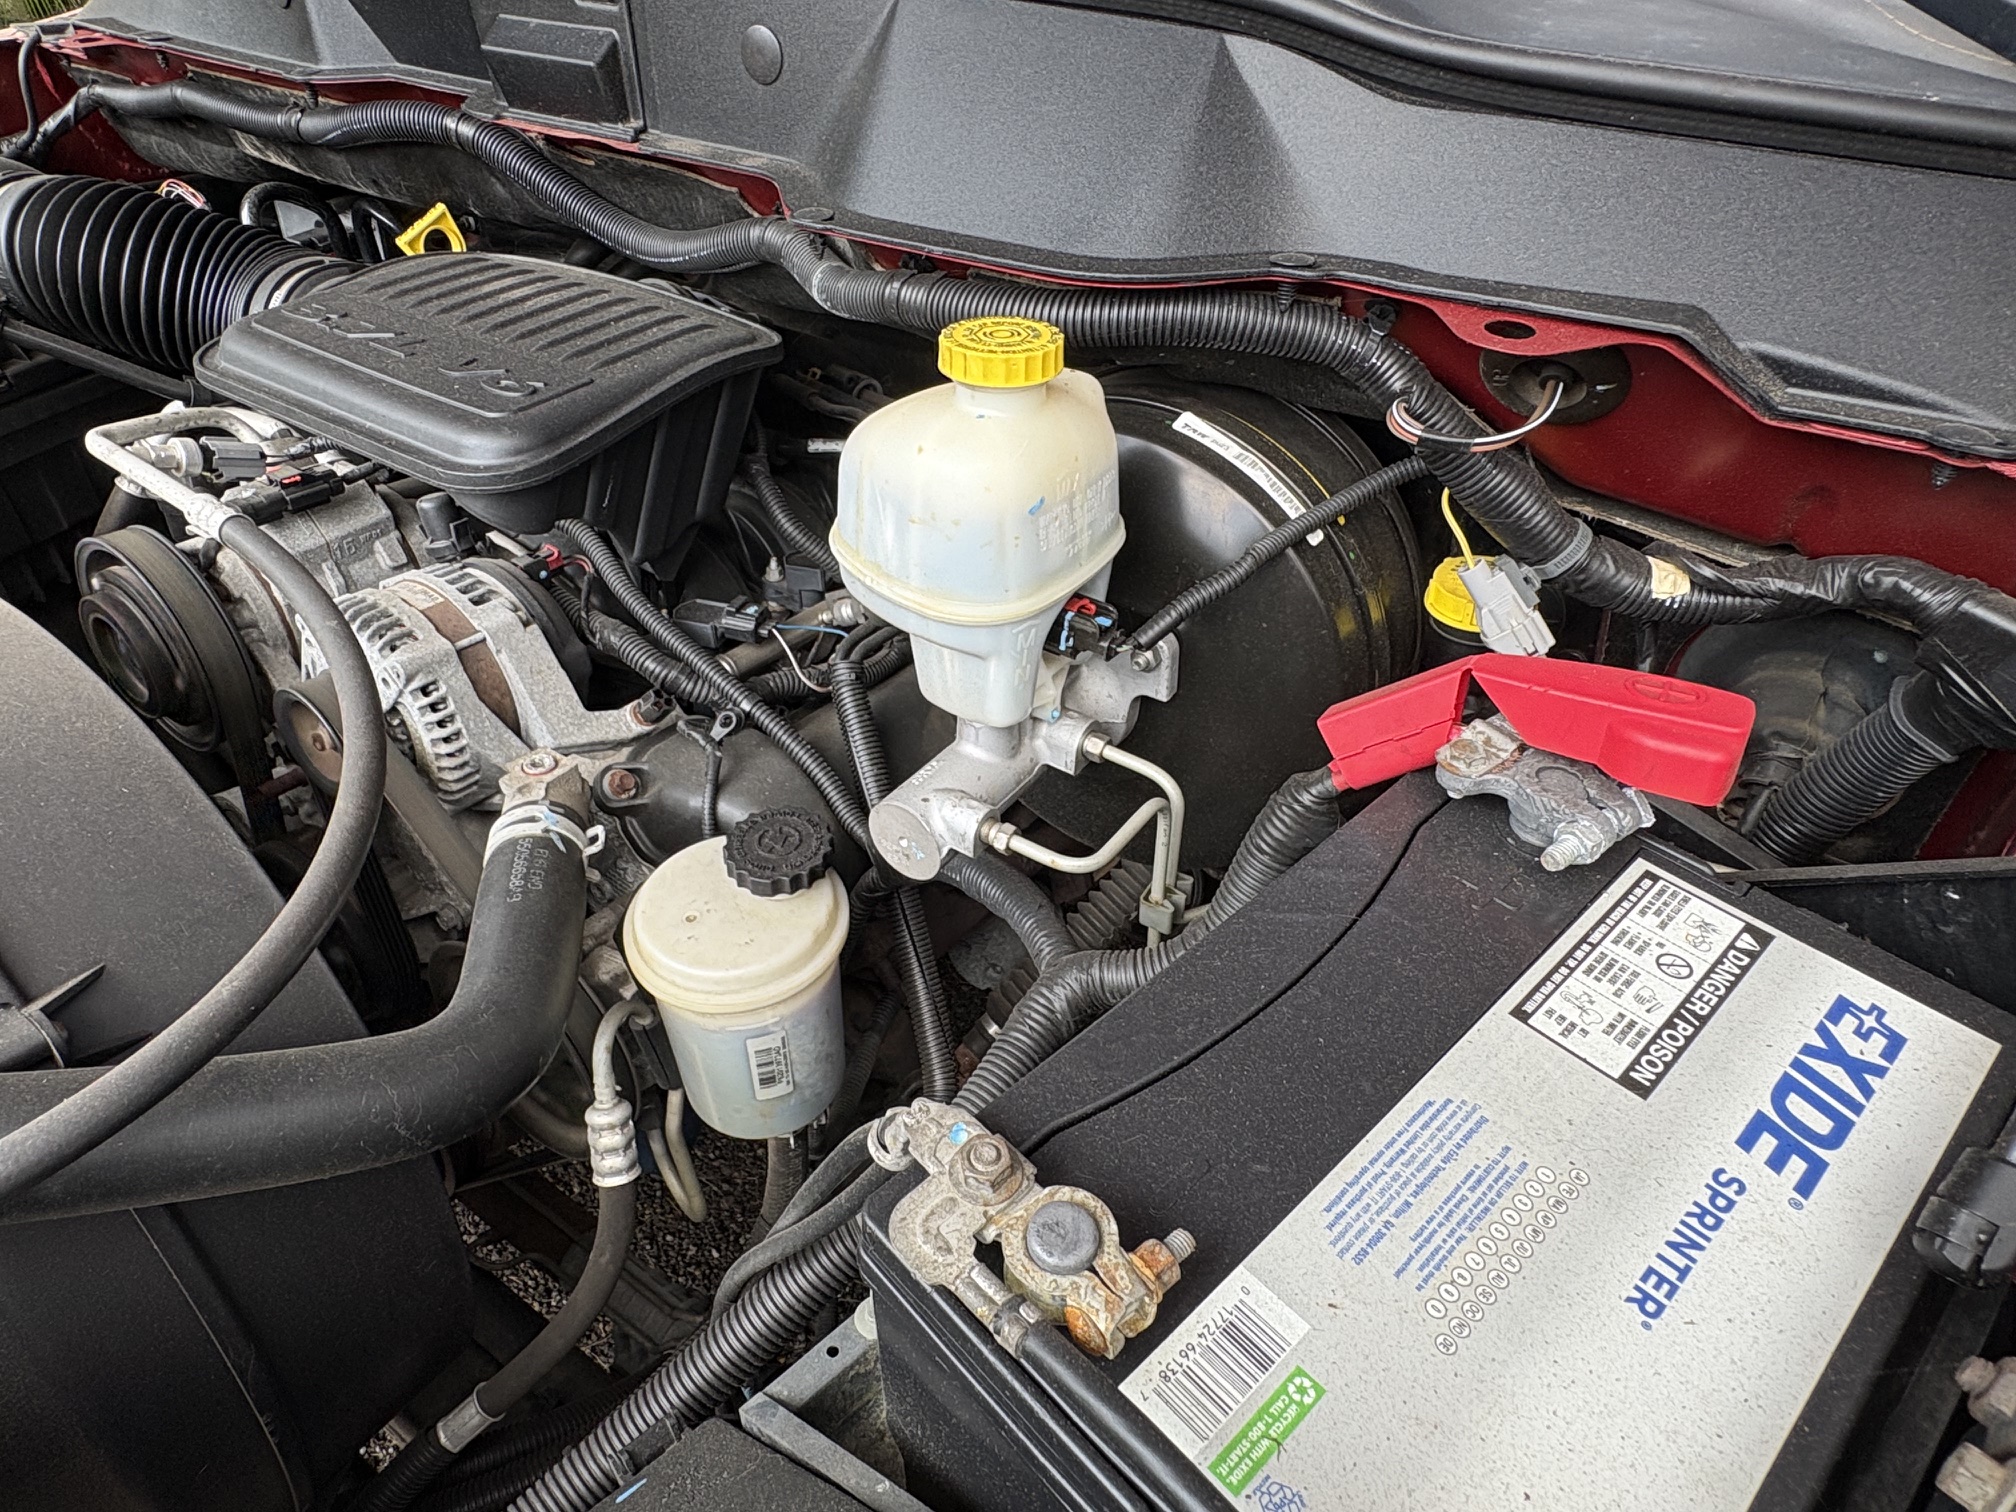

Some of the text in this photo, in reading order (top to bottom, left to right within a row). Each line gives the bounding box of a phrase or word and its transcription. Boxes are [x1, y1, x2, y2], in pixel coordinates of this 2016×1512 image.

[1181, 422, 1211, 439] TRW
[1014, 627, 1036, 687] MIN
[1628, 948, 1751, 1087] DANGER / POISON
[1734, 994, 1909, 1201] EXIDE
[1437, 1170, 1588, 1355] JA FE MA AP MY JU JL AU SE OC NO DE
[1623, 1167, 1747, 1321] SPRINTER
[1139, 1285, 1251, 1402] 0 17724 66138 7
[1248, 1435, 1272, 1461] WITH
[1267, 1393, 1291, 1417] CALL
[1267, 1402, 1301, 1439] RECYCLE
